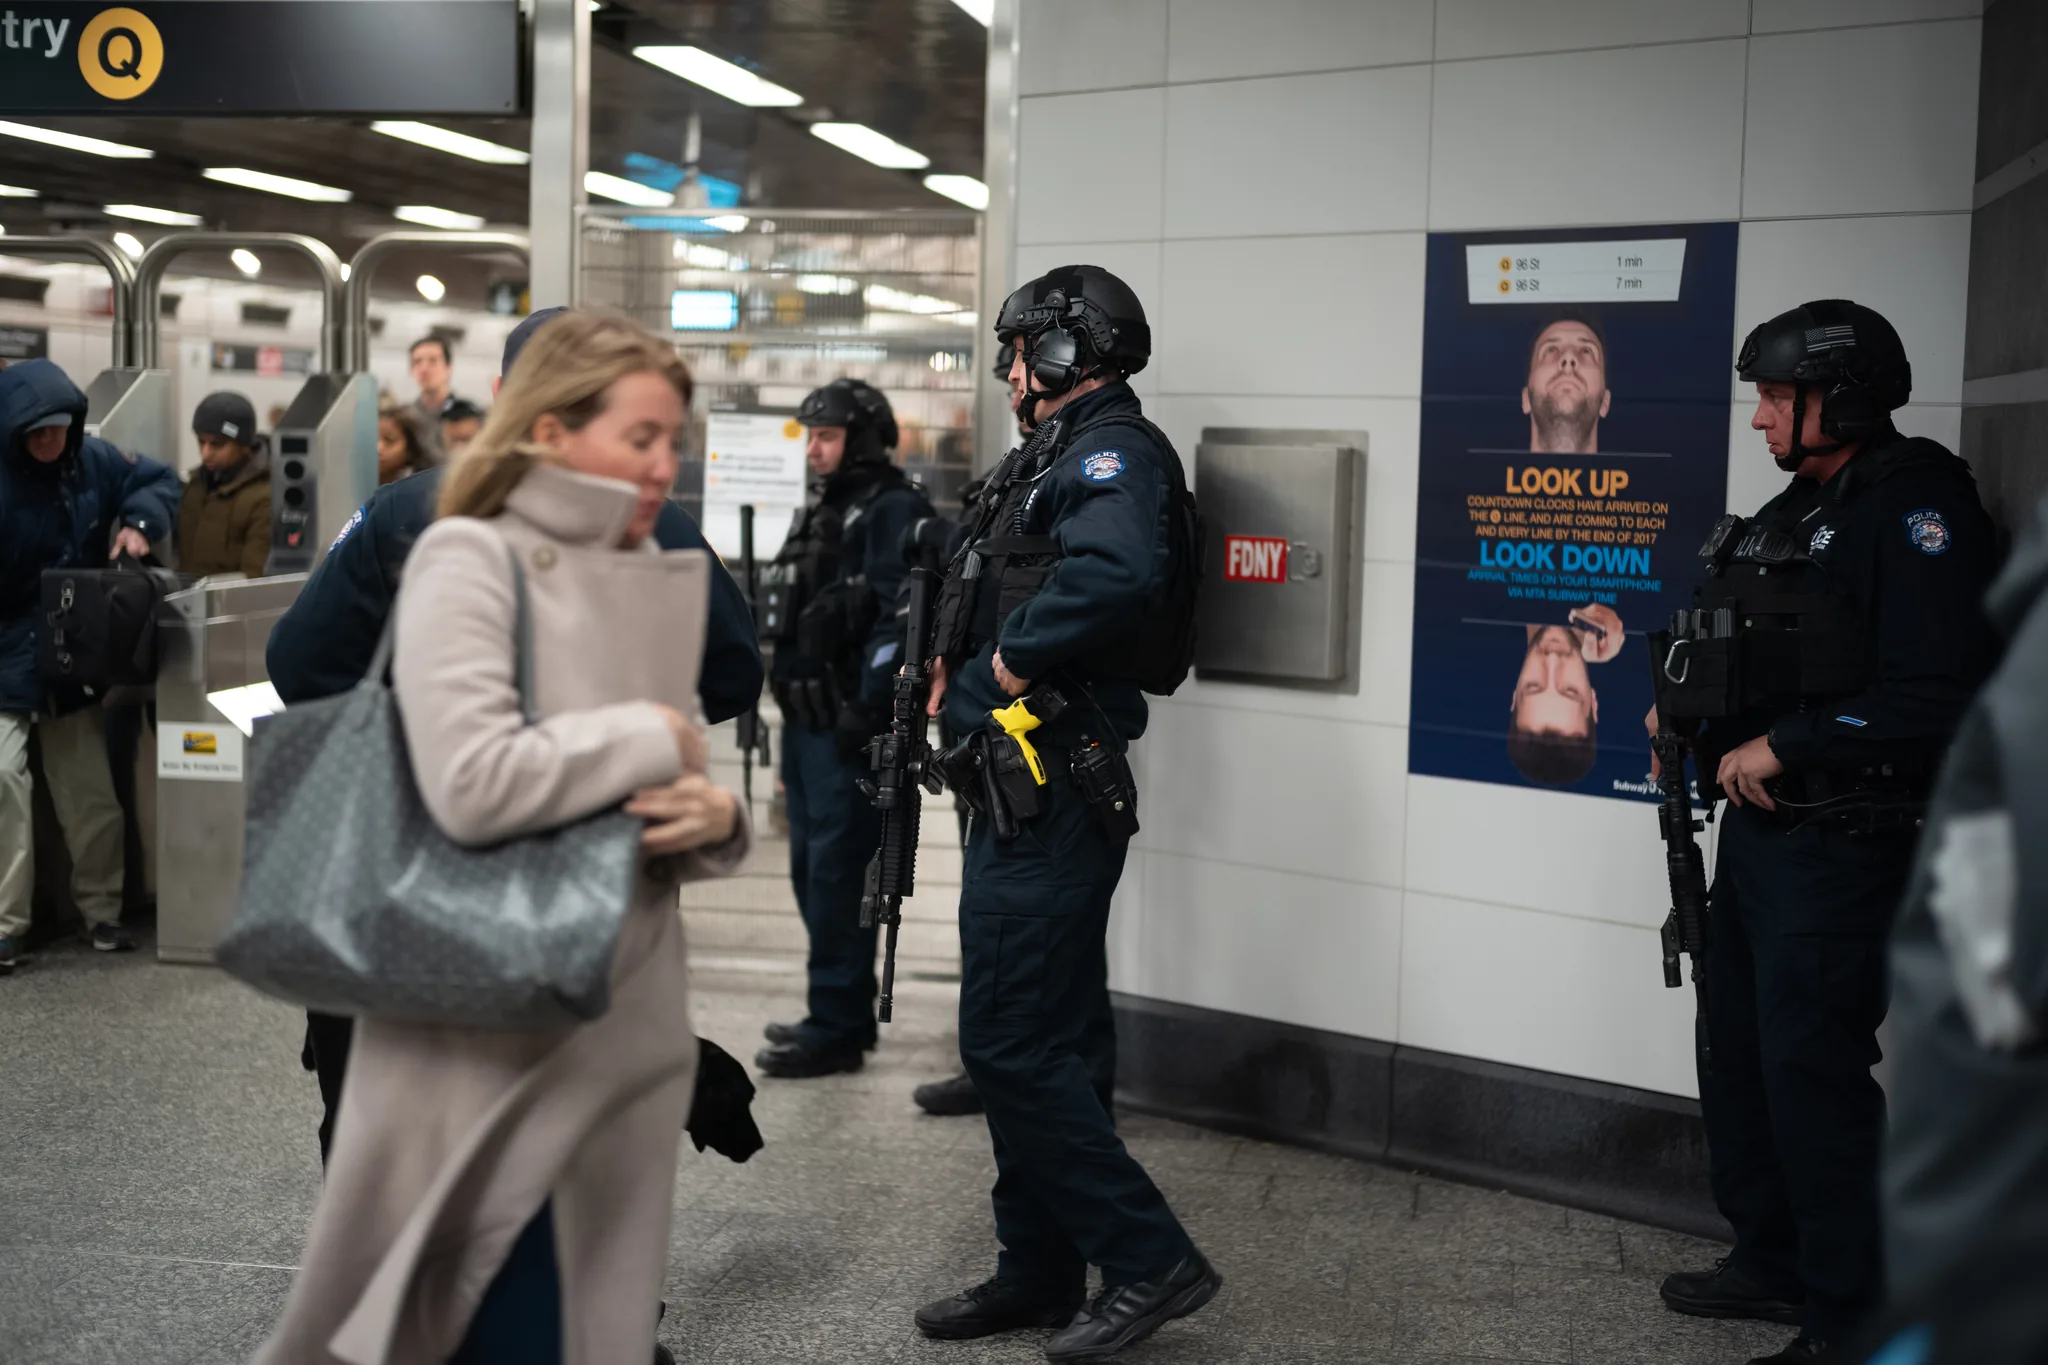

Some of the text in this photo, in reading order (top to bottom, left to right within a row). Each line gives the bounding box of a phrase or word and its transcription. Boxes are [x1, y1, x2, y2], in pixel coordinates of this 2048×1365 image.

[2, 10, 143, 80] try Q
[1515, 258, 1528, 271] 96
[1529, 257, 1540, 270] St
[1617, 256, 1622, 268] 1
[1624, 254, 1643, 268] min
[1515, 279, 1528, 291] 96
[1529, 278, 1540, 291] St
[1616, 277, 1622, 290] 7
[1624, 276, 1642, 290] min
[1085, 451, 1121, 464] POLICE
[1506, 466, 1629, 498] LOOK UP
[1467, 495, 1669, 515] COUNTDOWN CLOCKS HAVE ARRIVED ON
[1469, 509, 1488, 521] THE
[1503, 512, 1527, 524] LINE,
[1530, 513, 1551, 525] AND
[1553, 513, 1573, 526] ARE
[1575, 514, 1618, 528] COMING
[1620, 515, 1634, 528] TO
[1636, 516, 1666, 530] EACH
[1907, 512, 1944, 527] POLICE
[1475, 525, 1657, 545] AND EVERY LINE BY THE END OF 2017
[1229, 540, 1284, 579] FDNY
[1480, 540, 1650, 576] LOOK DOWN
[1468, 569, 1662, 592] ARRIVAL TIMES ON YOUR SMARTPHONE
[1508, 586, 1617, 604] VIA MTA SUBWAY TIME
[1613, 780, 1648, 795] Subway
